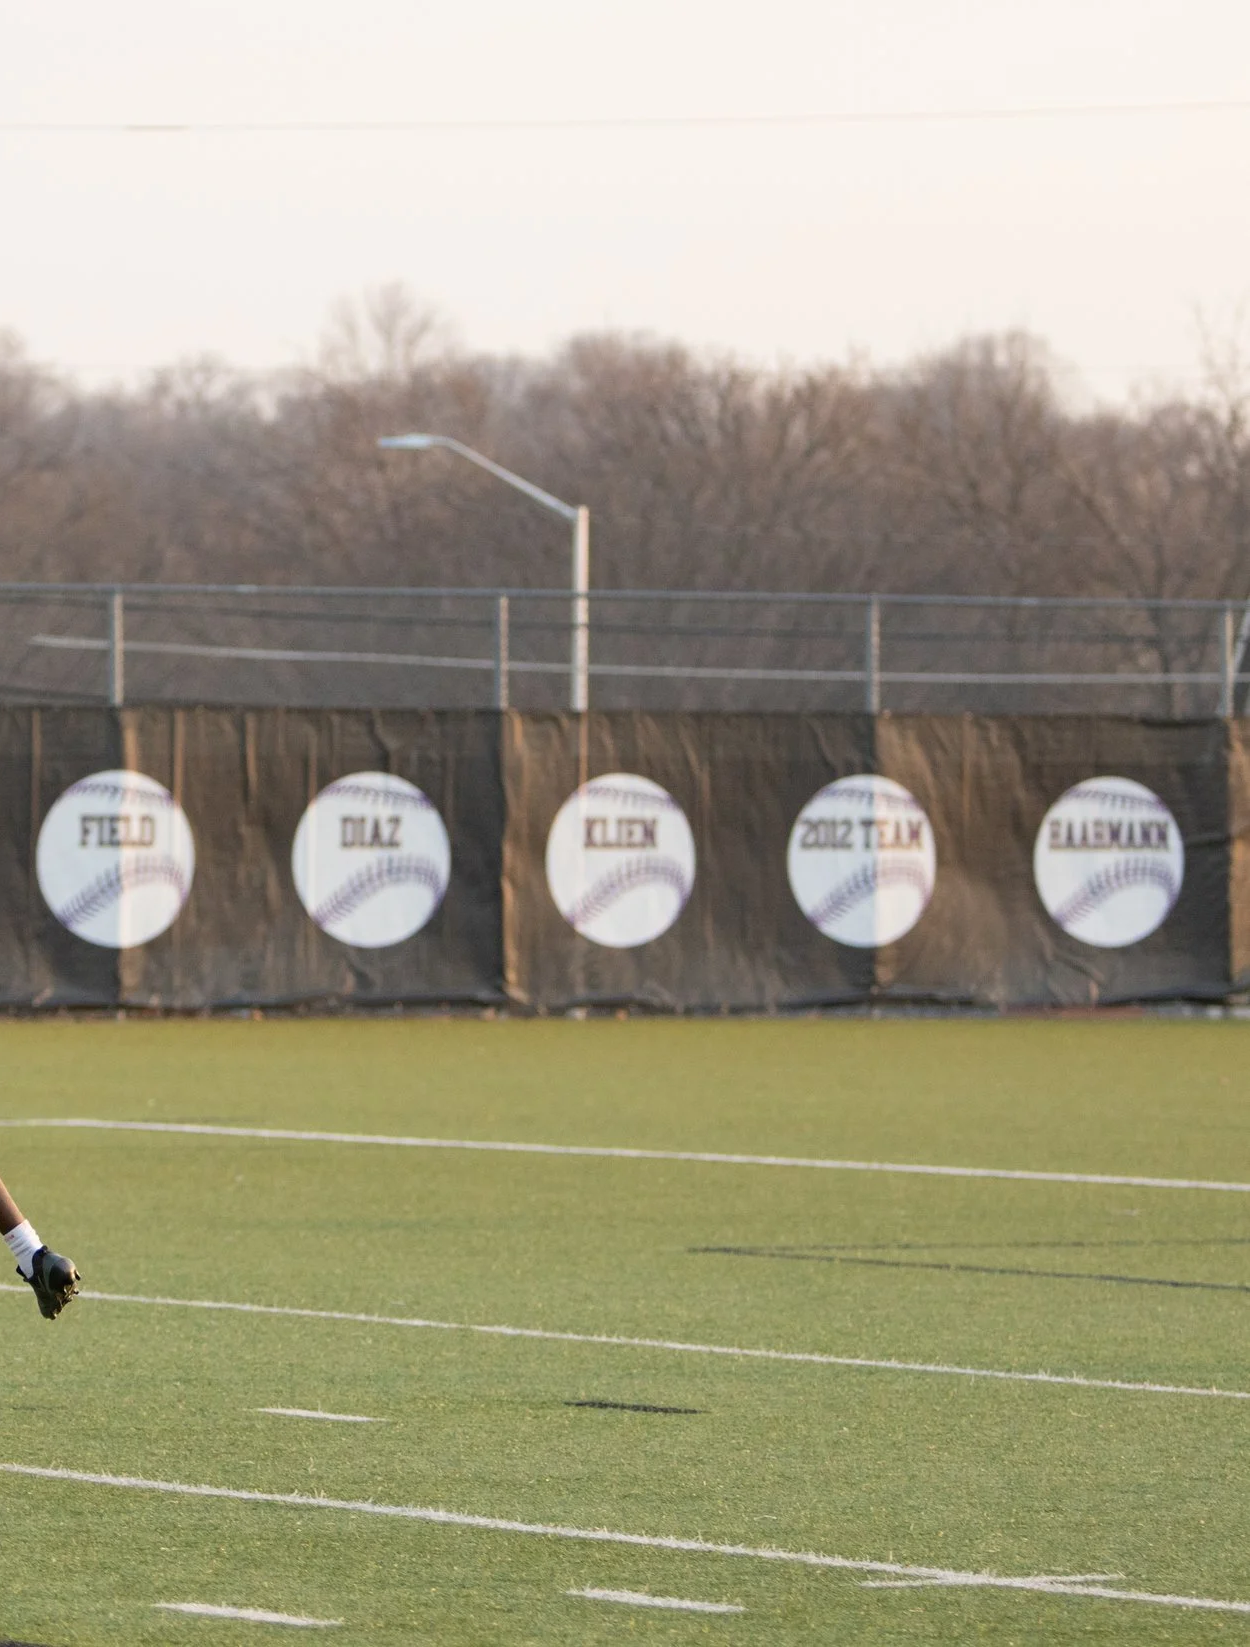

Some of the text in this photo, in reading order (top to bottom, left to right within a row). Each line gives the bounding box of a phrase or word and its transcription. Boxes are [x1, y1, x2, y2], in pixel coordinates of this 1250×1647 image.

[79, 814, 155, 848] FIELD
[340, 815, 402, 848] DIAZ
[583, 816, 658, 850] KLIEN
[798, 817, 924, 851] 2012 TEAM
